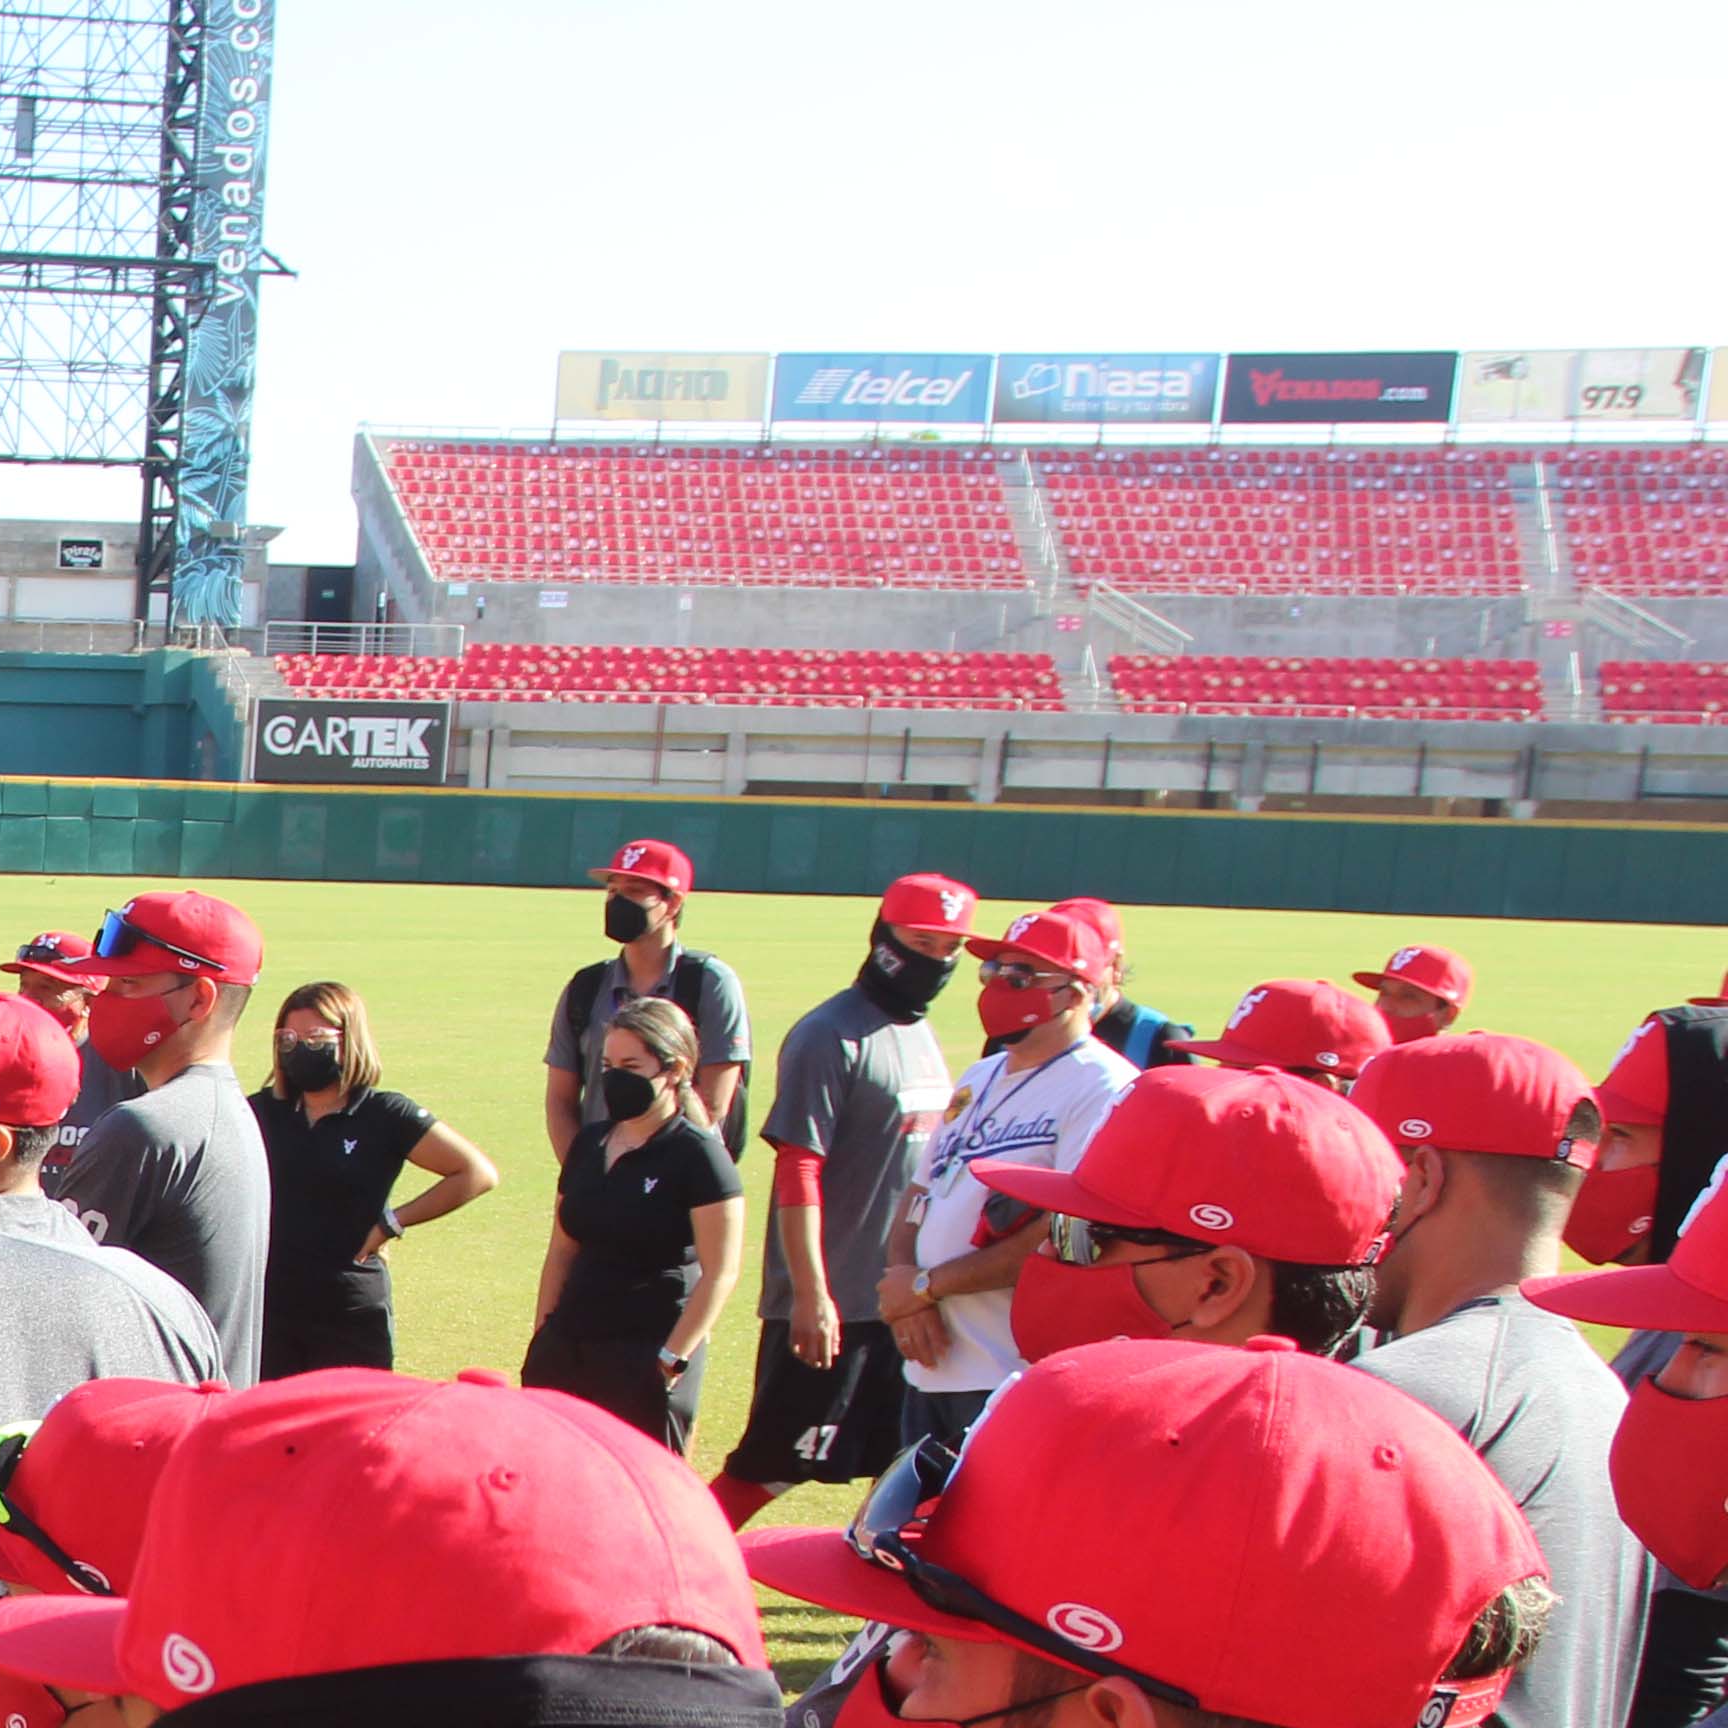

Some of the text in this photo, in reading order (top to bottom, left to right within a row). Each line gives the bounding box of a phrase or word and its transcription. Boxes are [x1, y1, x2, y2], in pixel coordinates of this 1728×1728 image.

[840, 368, 973, 406] telcel
[1580, 385, 1642, 409] 97.9
[263, 716, 432, 757] CARTEK
[351, 757, 430, 769] AUTOPARTES
[793, 1425, 839, 1461] 47
